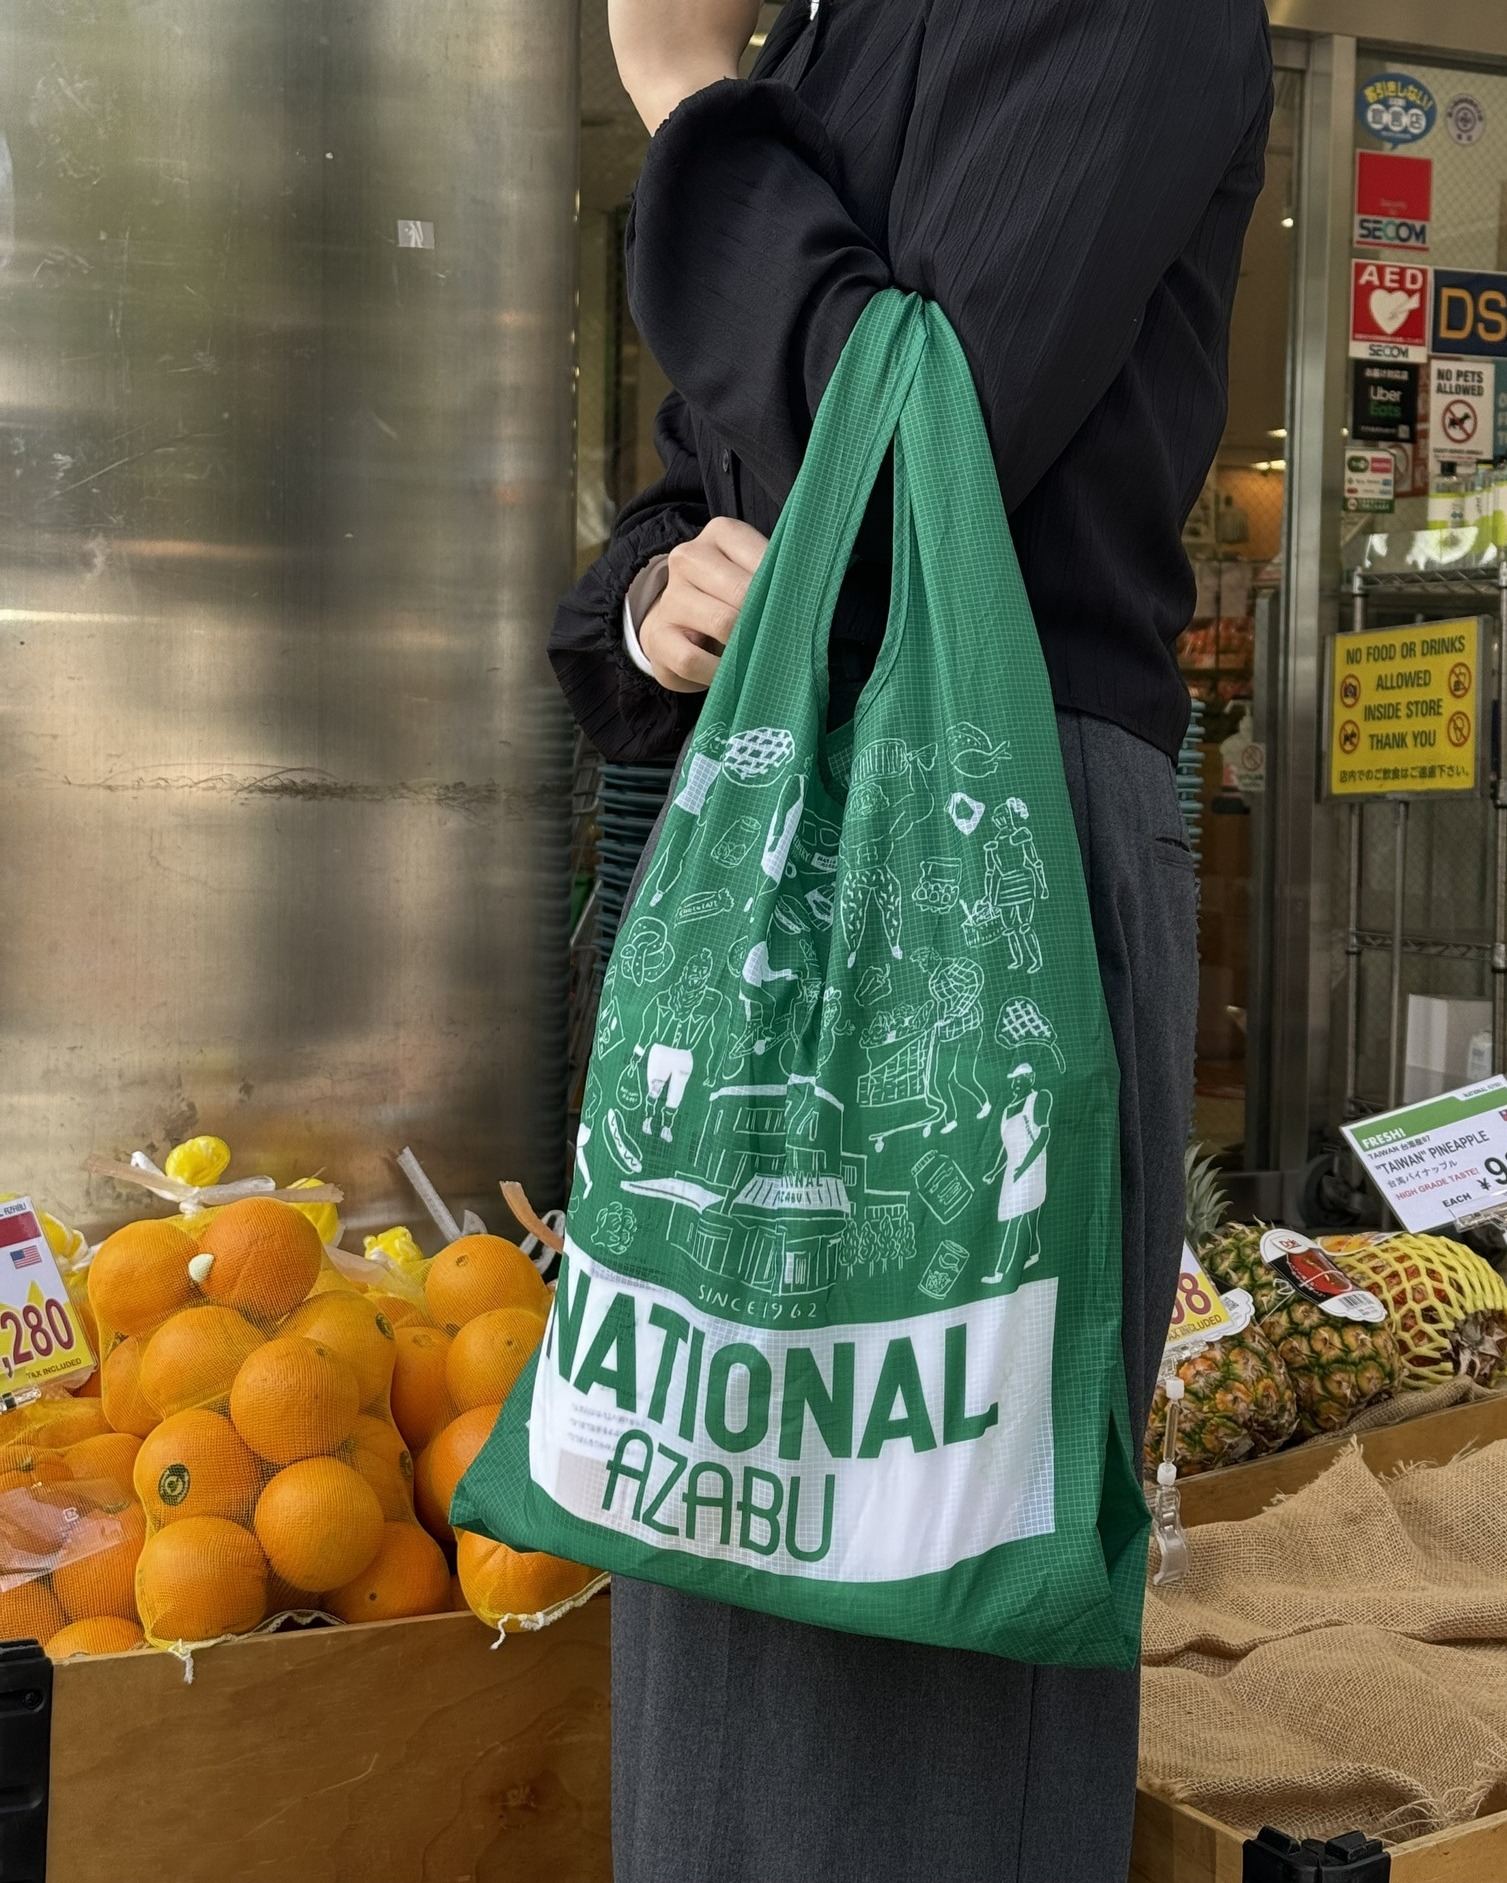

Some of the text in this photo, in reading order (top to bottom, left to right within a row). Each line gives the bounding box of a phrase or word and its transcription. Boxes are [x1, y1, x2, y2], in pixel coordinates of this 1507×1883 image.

[1359, 219, 1426, 244] SECOM
[1359, 265, 1423, 289] AED
[1440, 287, 1507, 342] DS
[1368, 344, 1409, 358] SECOM
[1437, 369, 1484, 383] NO PETS
[1370, 385, 1403, 401] Uber
[1436, 383, 1484, 396] ALLOWED
[1346, 635, 1466, 664] NO FOOD OR DRINKS
[1376, 669, 1431, 691] ALLOWED
[1364, 698, 1443, 721] INSIDE STORE
[1369, 729, 1437, 750] THANK YOU
[1361, 1127, 1407, 1149] FRESH!
[1427, 1130, 1490, 1159] PINEAPPLE
[1368, 1145, 1400, 1160] TAIWAN
[1396, 1188, 1418, 1200] HIGH
[1418, 1178, 1449, 1193] GRADE
[1442, 1192, 1472, 1208] EACH
[699, 1284, 817, 1320] SINCE 1962
[1180, 1314, 1223, 1337] INCLUDED
[548, 1251, 999, 1460] NATIONAL
[26, 1357, 82, 1379] TAX INCLUDED
[601, 1429, 836, 1563] AZABU
